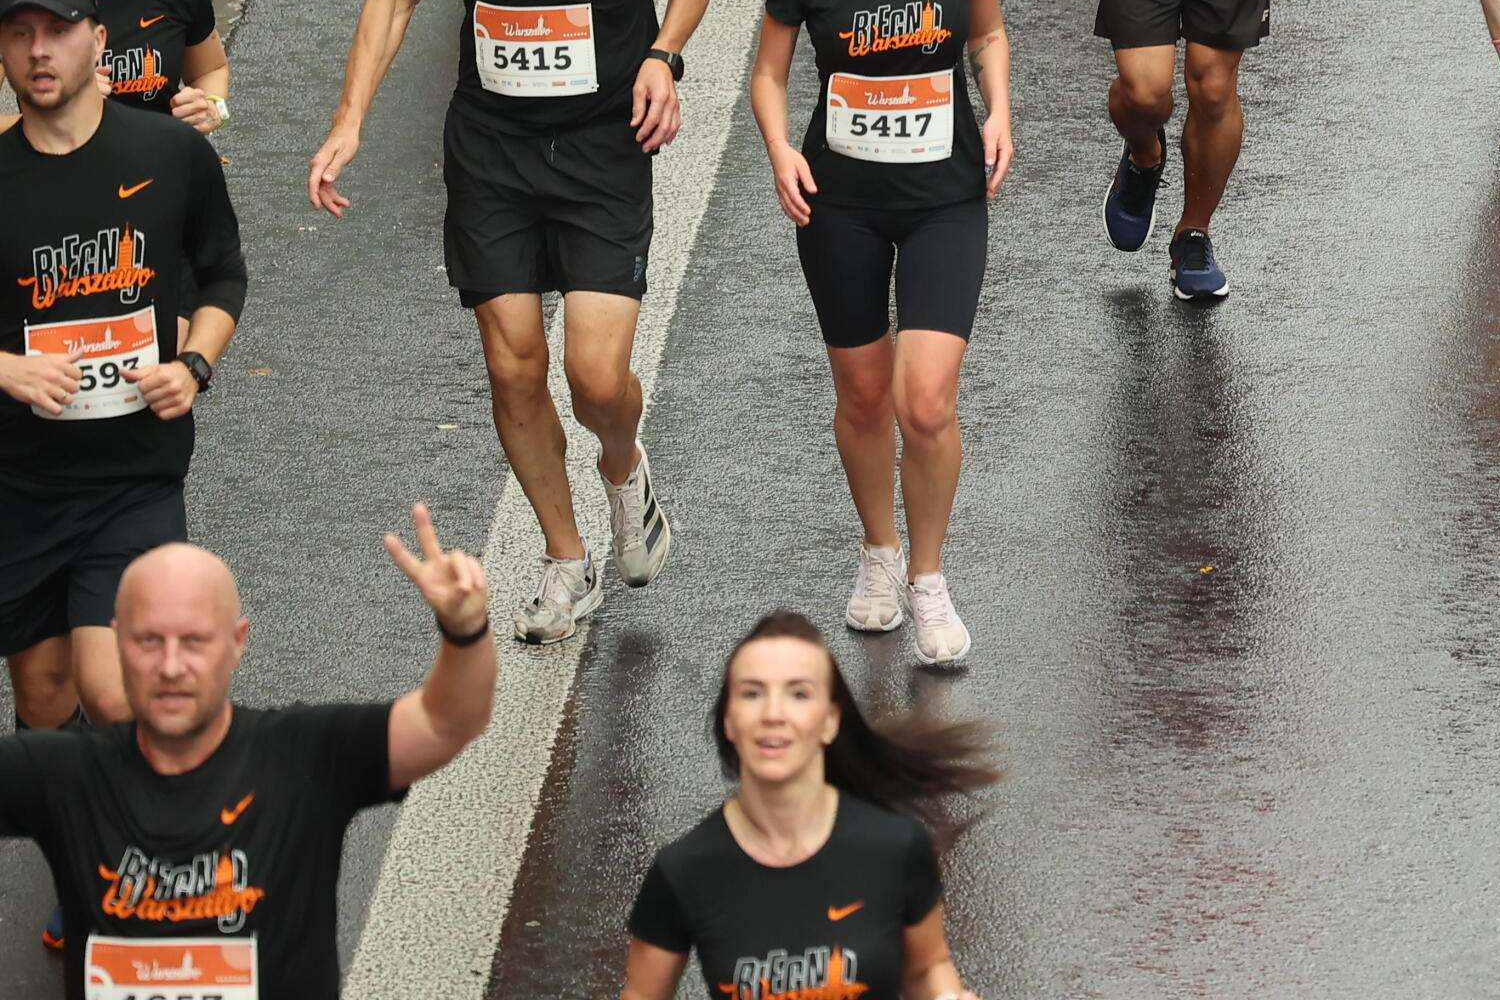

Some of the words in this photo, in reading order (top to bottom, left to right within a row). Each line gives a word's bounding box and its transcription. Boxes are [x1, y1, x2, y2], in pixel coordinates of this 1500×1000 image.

[839, 24, 952, 57] Warszawo
[494, 45, 572, 71] 5415
[850, 113, 932, 138] 5417
[17, 265, 156, 310] Warszawo
[79, 357, 139, 392] 593
